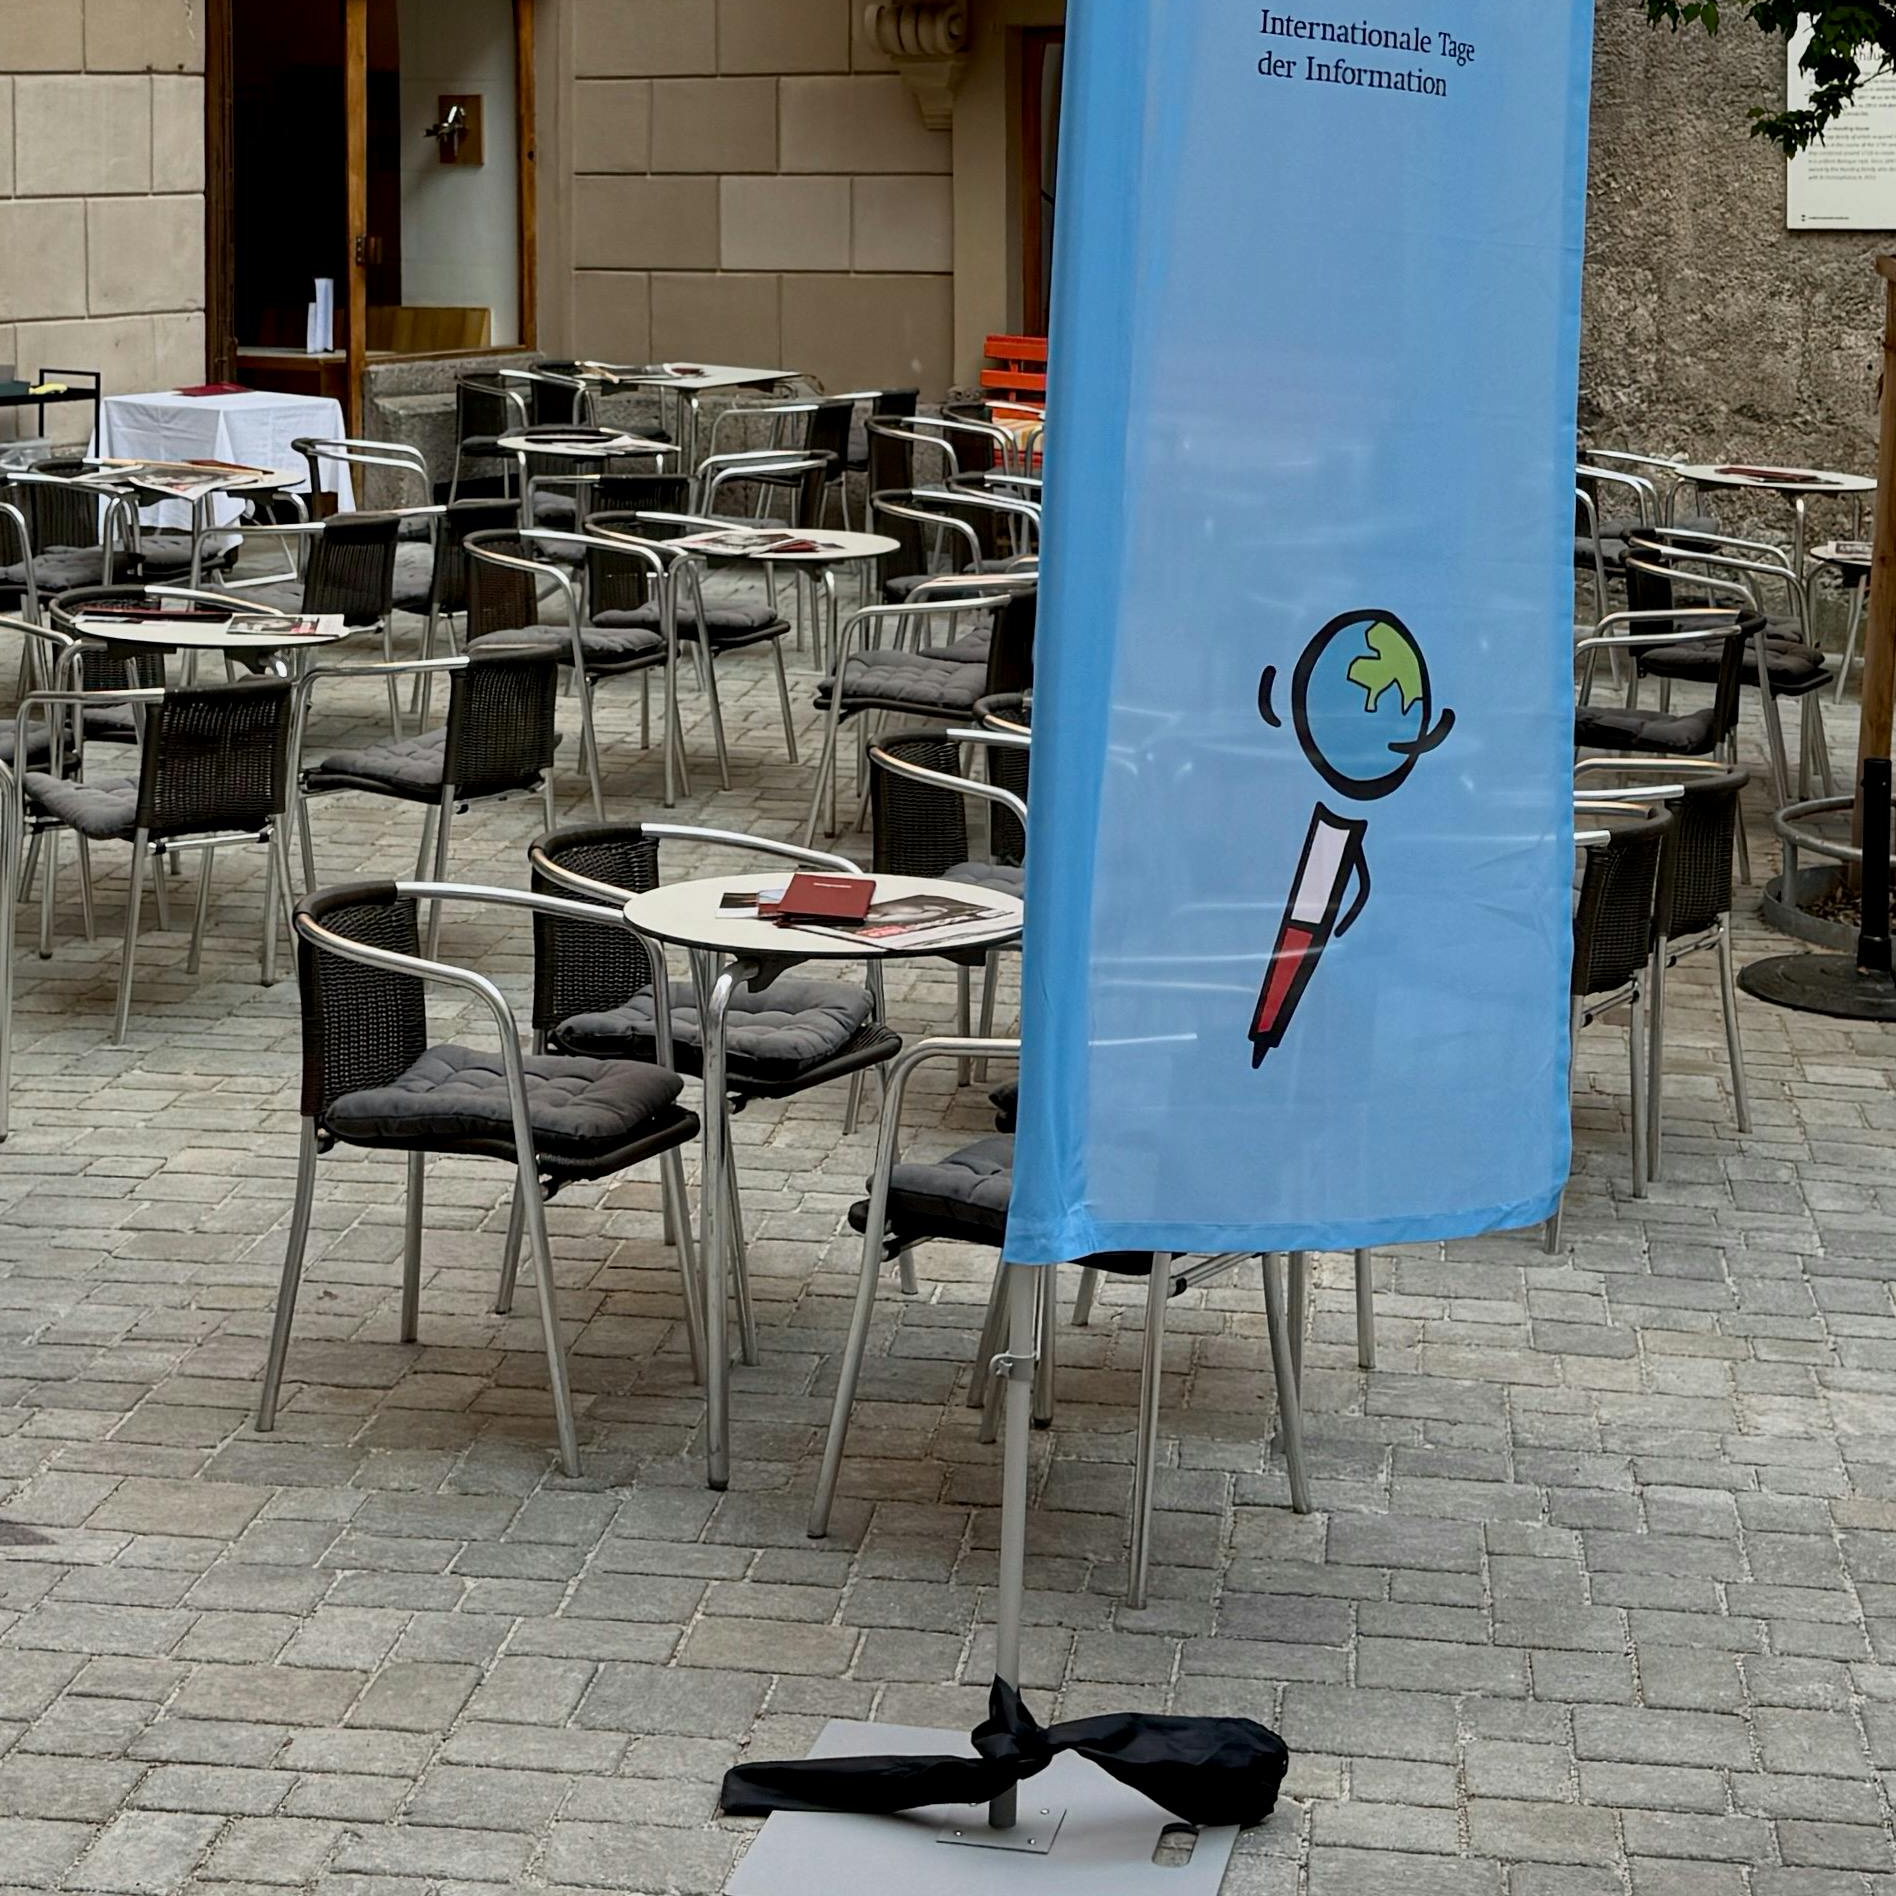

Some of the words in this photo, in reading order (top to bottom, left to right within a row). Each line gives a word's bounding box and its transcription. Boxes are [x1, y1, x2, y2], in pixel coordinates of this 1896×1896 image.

[1259, 9, 1432, 53] Internationale
[1438, 32, 1475, 67] Tage
[1258, 51, 1296, 78] der
[1305, 56, 1447, 97] Information
